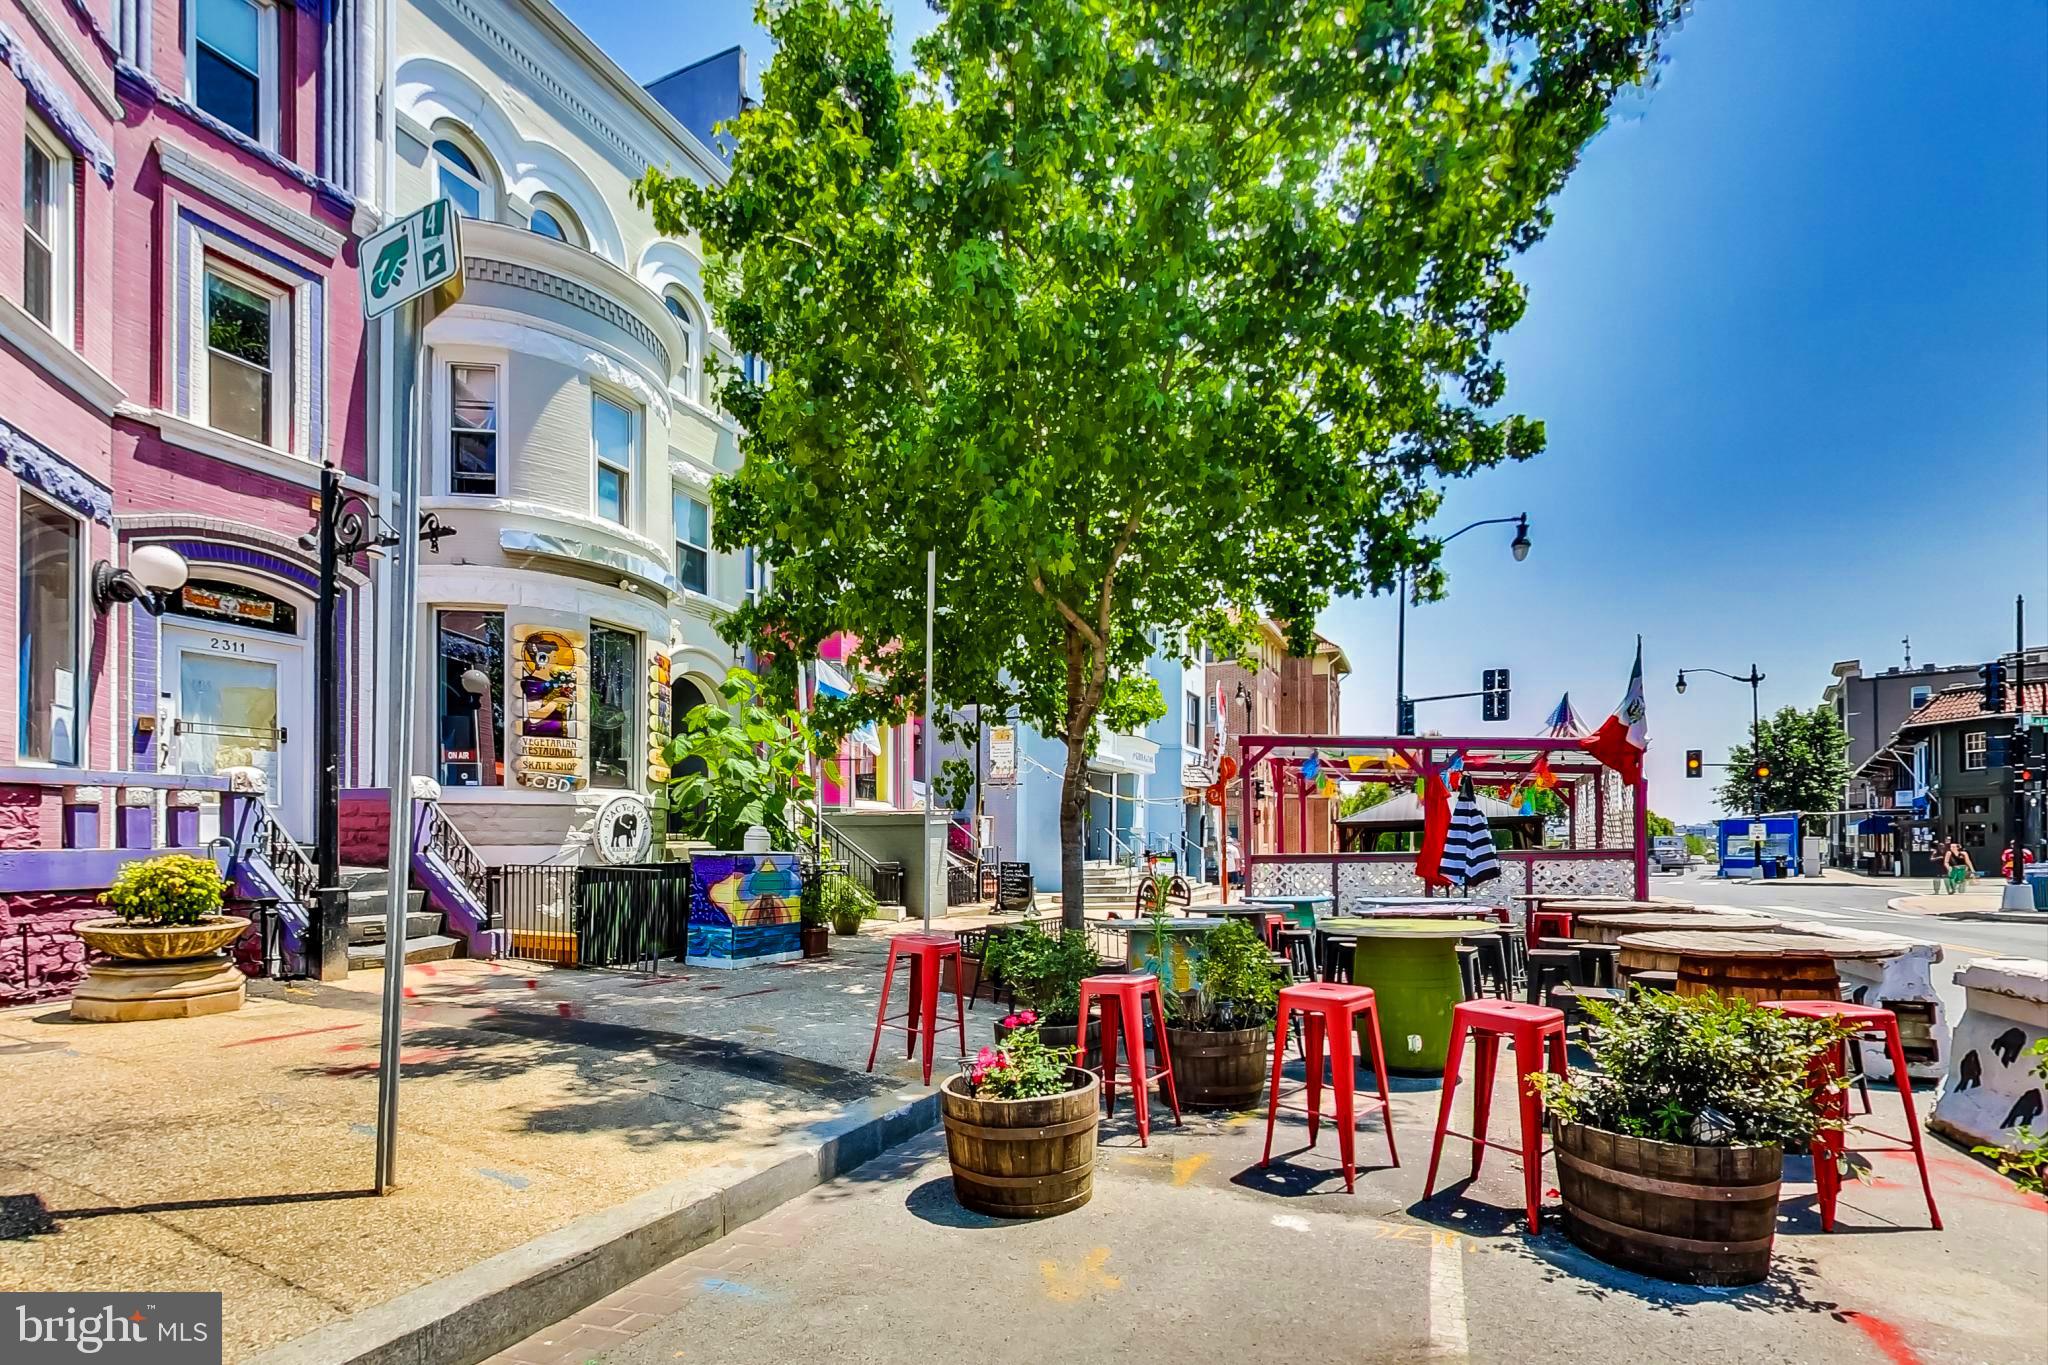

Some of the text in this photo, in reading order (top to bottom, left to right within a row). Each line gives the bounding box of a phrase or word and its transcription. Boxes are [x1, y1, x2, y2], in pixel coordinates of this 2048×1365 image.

[426, 204, 436, 235] 4
[210, 638, 245, 653] 2311
[522, 738, 577, 748] VEGETARIAN
[447, 751, 470, 760] ON AIR
[522, 747, 577, 757] RESTAURANT
[522, 761, 578, 771] SKATE SHOP
